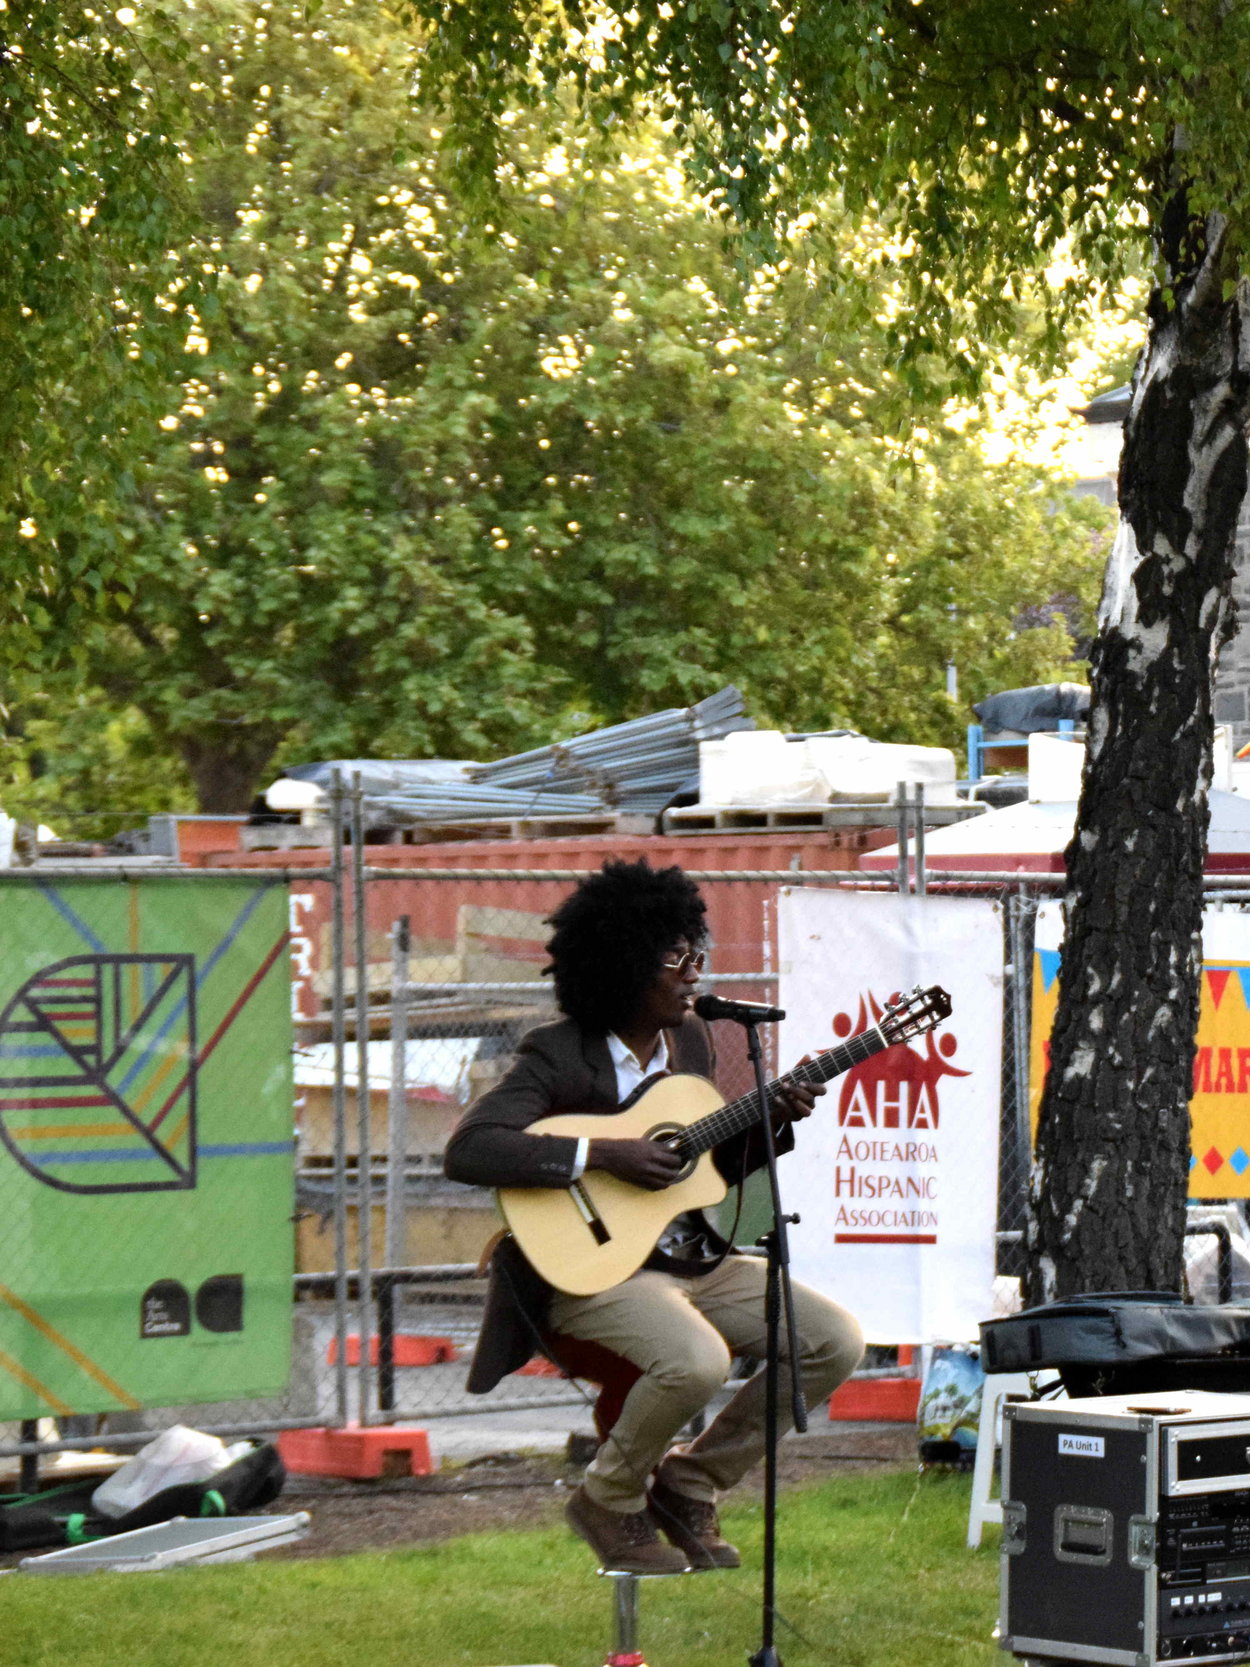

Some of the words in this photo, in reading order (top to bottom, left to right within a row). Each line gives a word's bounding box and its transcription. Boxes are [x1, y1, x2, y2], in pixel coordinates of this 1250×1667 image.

[843, 1079, 935, 1129] AHA
[836, 1133, 939, 1163] AOTEAROA
[835, 1165, 938, 1200] HISPANIC
[835, 1204, 938, 1228] ASSOCIATION
[1062, 1439, 1074, 1450] PA
[1075, 1440, 1093, 1452] Unit
